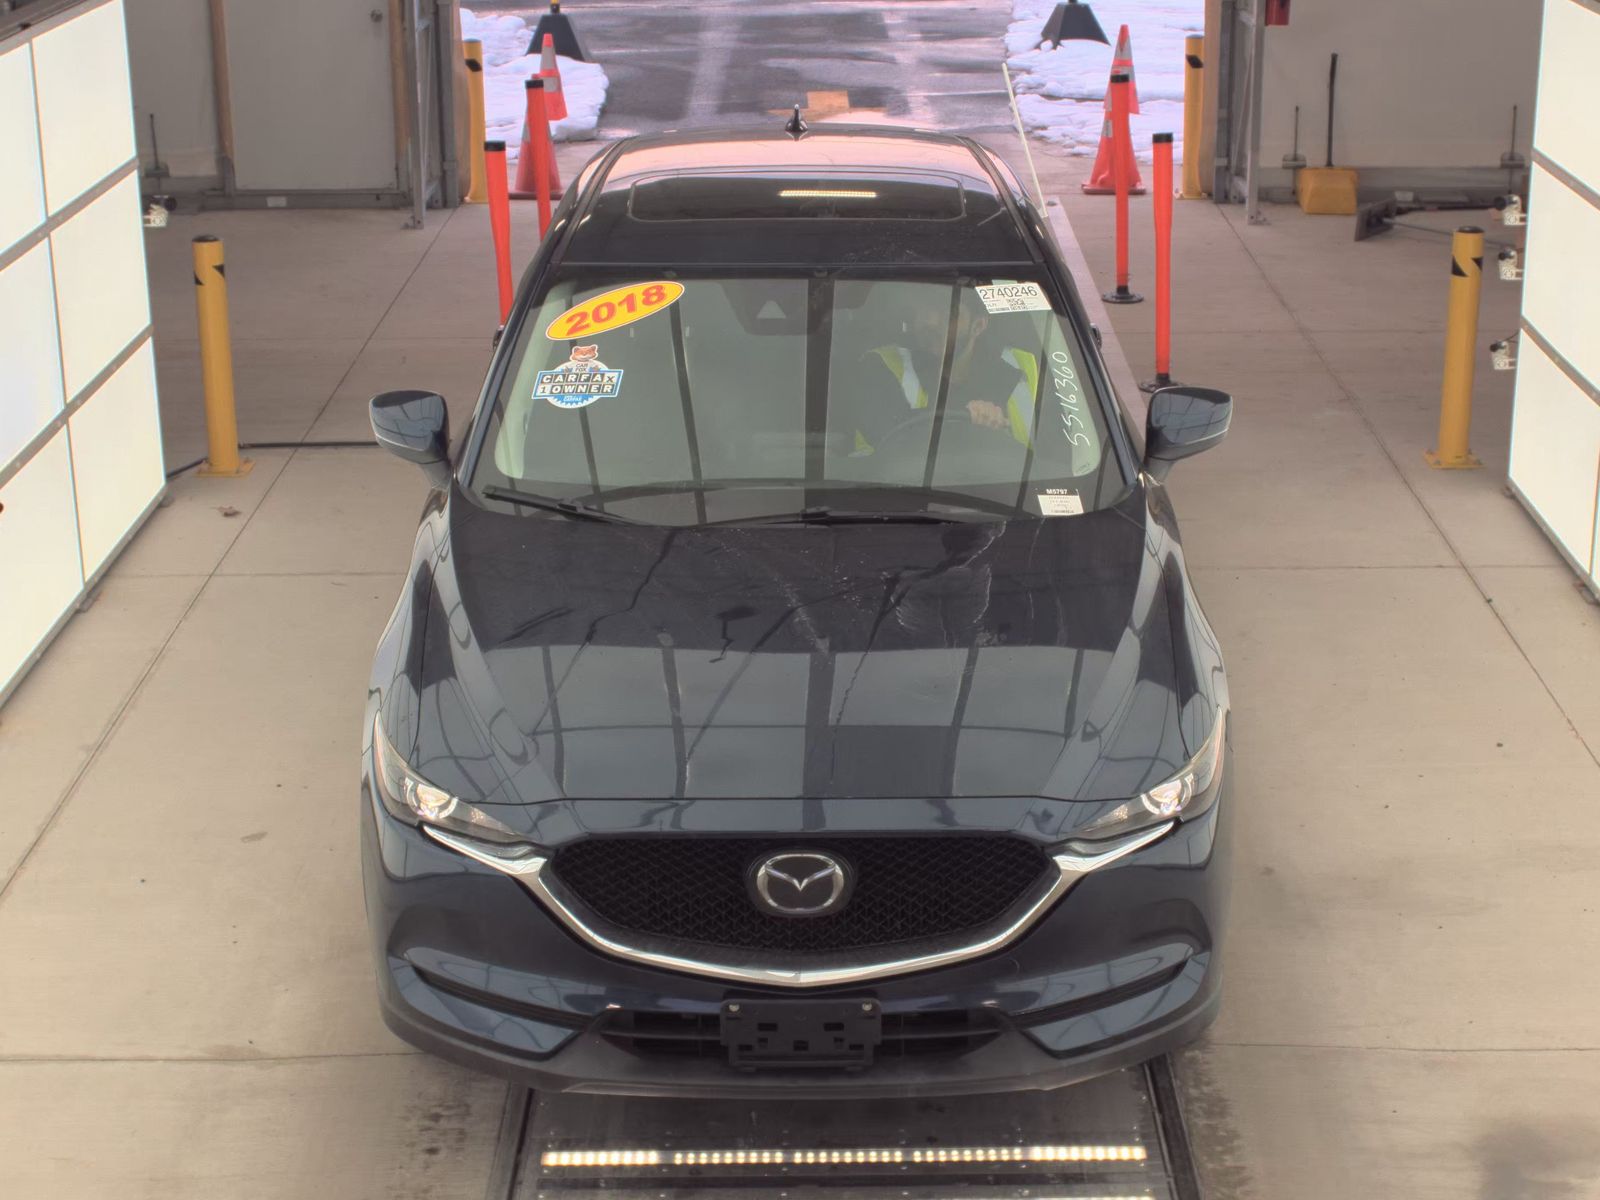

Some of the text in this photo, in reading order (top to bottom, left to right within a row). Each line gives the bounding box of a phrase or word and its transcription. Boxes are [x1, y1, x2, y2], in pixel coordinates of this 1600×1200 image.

[979, 286, 1038, 300] 2740246
[565, 285, 667, 336] 2018
[542, 374, 615, 383] CARFAX
[1052, 351, 1091, 447] 5516360
